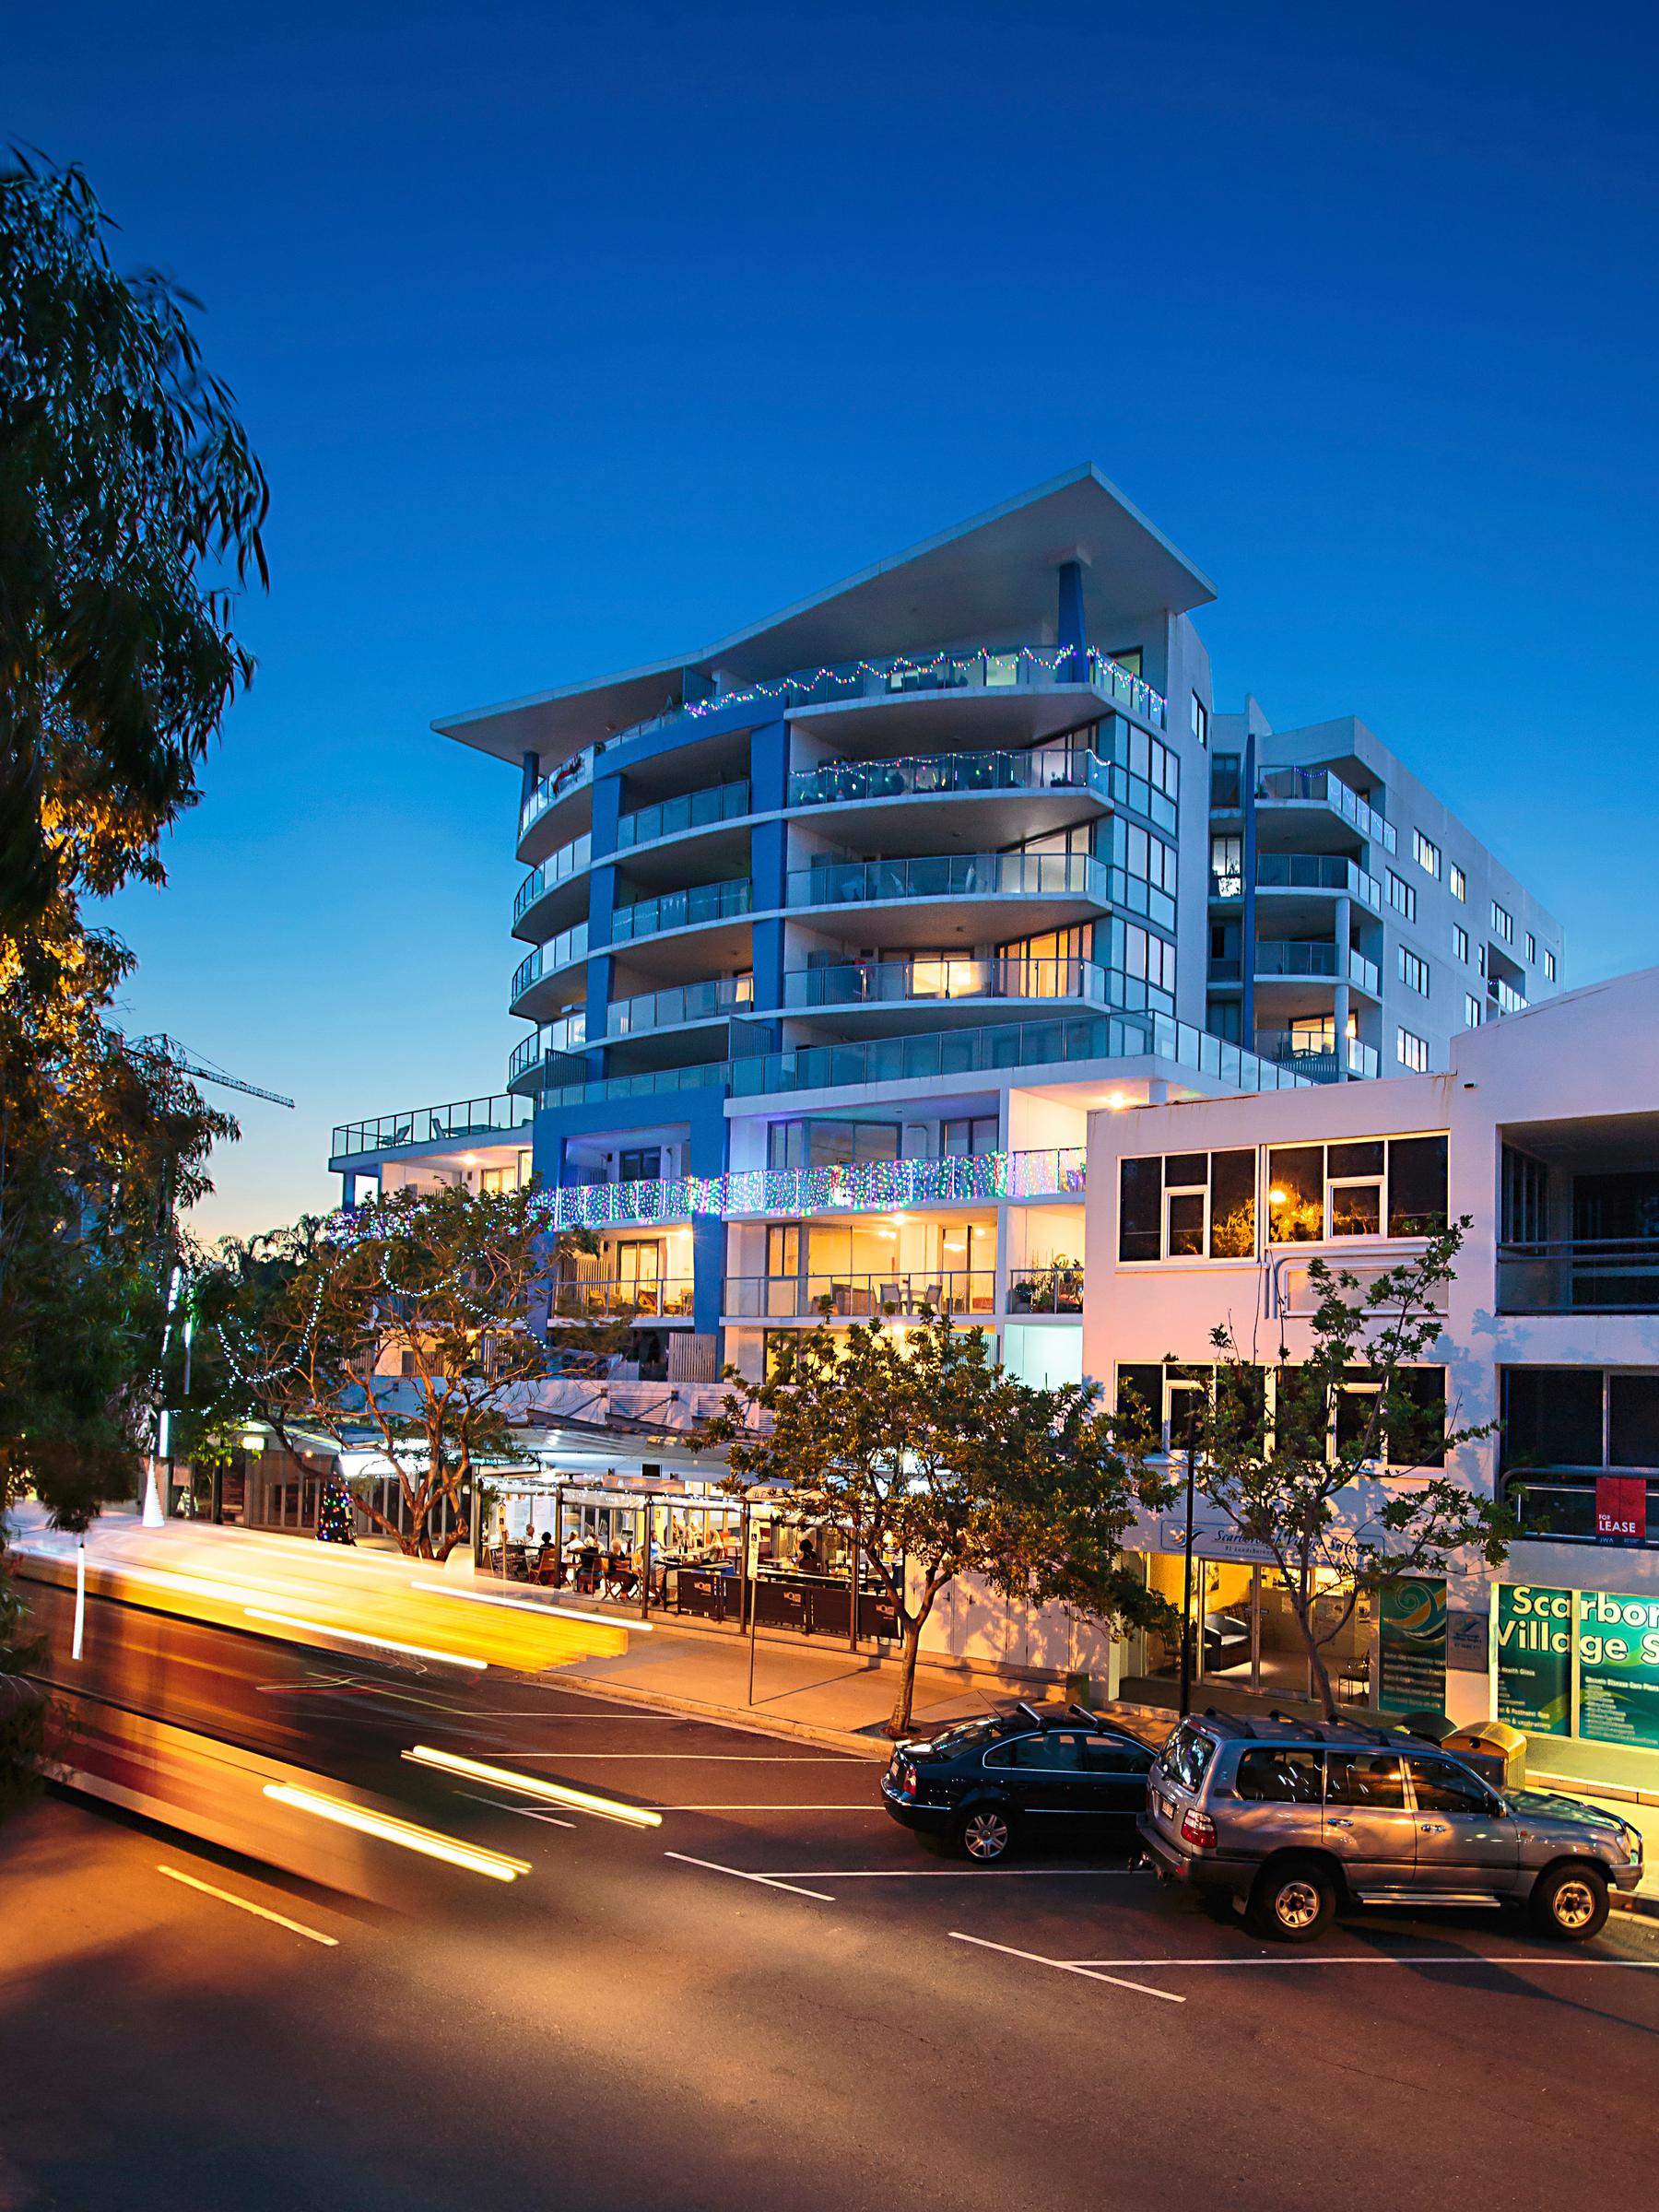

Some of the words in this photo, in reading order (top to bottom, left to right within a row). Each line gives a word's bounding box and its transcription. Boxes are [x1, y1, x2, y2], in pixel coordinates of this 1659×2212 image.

[1599, 1521, 1636, 1534] LEASE
[1512, 1585, 1659, 1628] Scarbor
[1498, 1620, 1628, 1665] Village
